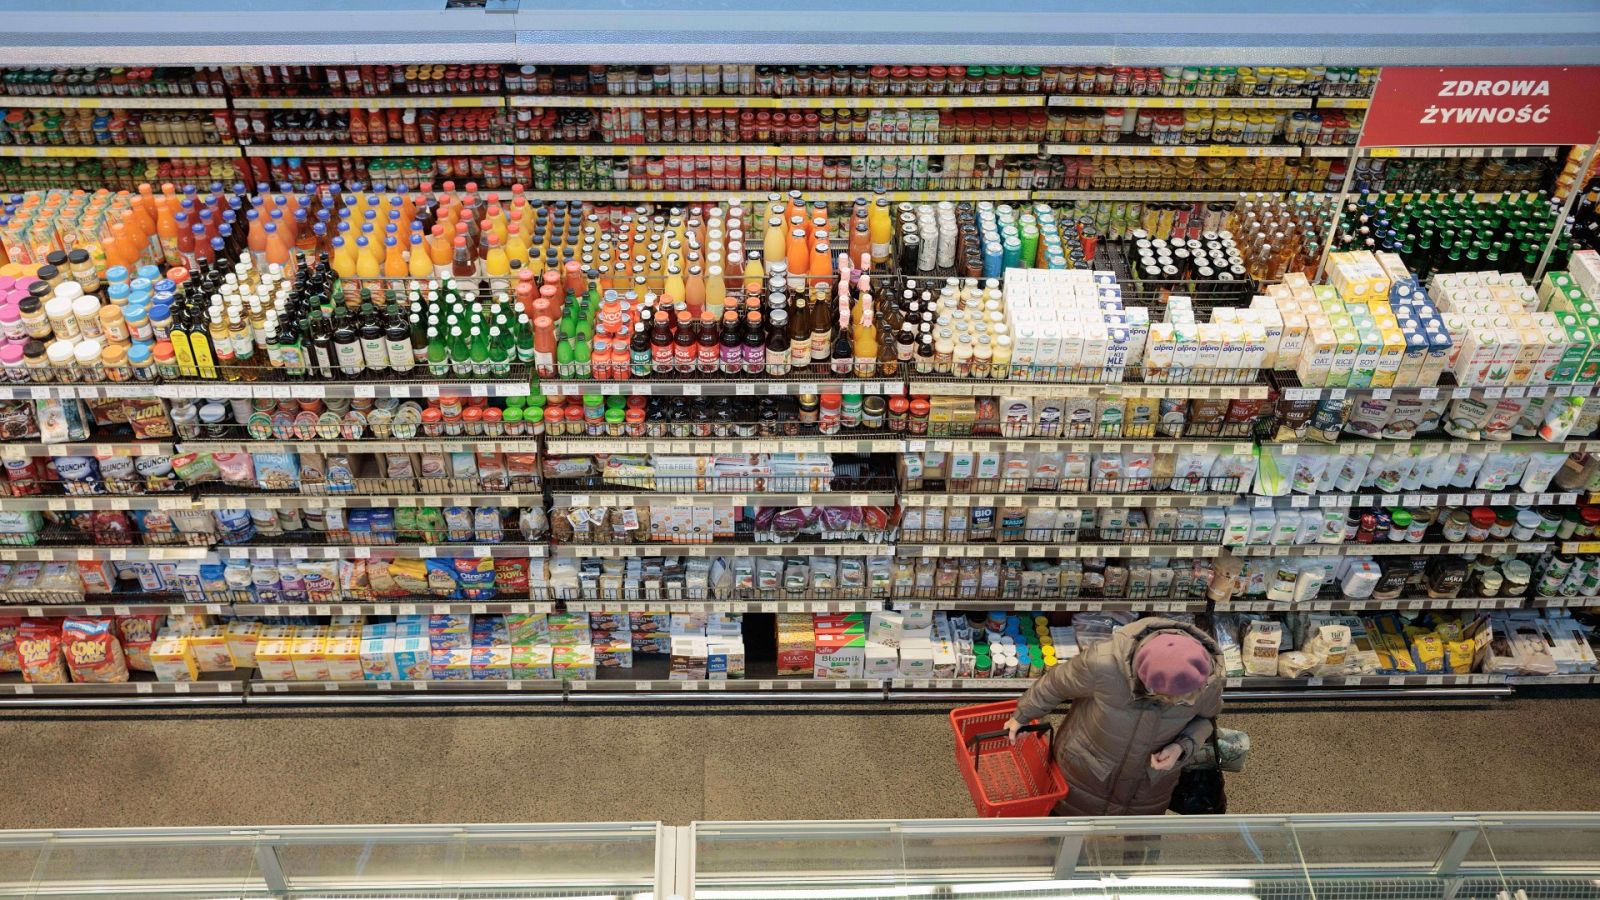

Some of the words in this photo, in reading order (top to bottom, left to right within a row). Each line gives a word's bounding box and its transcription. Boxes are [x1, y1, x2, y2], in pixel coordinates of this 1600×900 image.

[1438, 81, 1549, 96] ZDROWA
[1420, 104, 1550, 123] ŻYWNOŚĆ
[1153, 344, 1174, 352] alpro
[1222, 345, 1243, 353] alpro
[1245, 345, 1264, 353] alpro
[135, 404, 163, 420] LION
[1361, 408, 1381, 416] Chia
[1458, 402, 1486, 416] Ksylitol
[56, 462, 87, 473] CRUNCHY
[101, 460, 131, 473] RUNCHY
[136, 455, 171, 472] CRUNCHY
[974, 509, 992, 517] BIO
[19, 639, 51, 656] CORN
[71, 641, 106, 656] CORN
